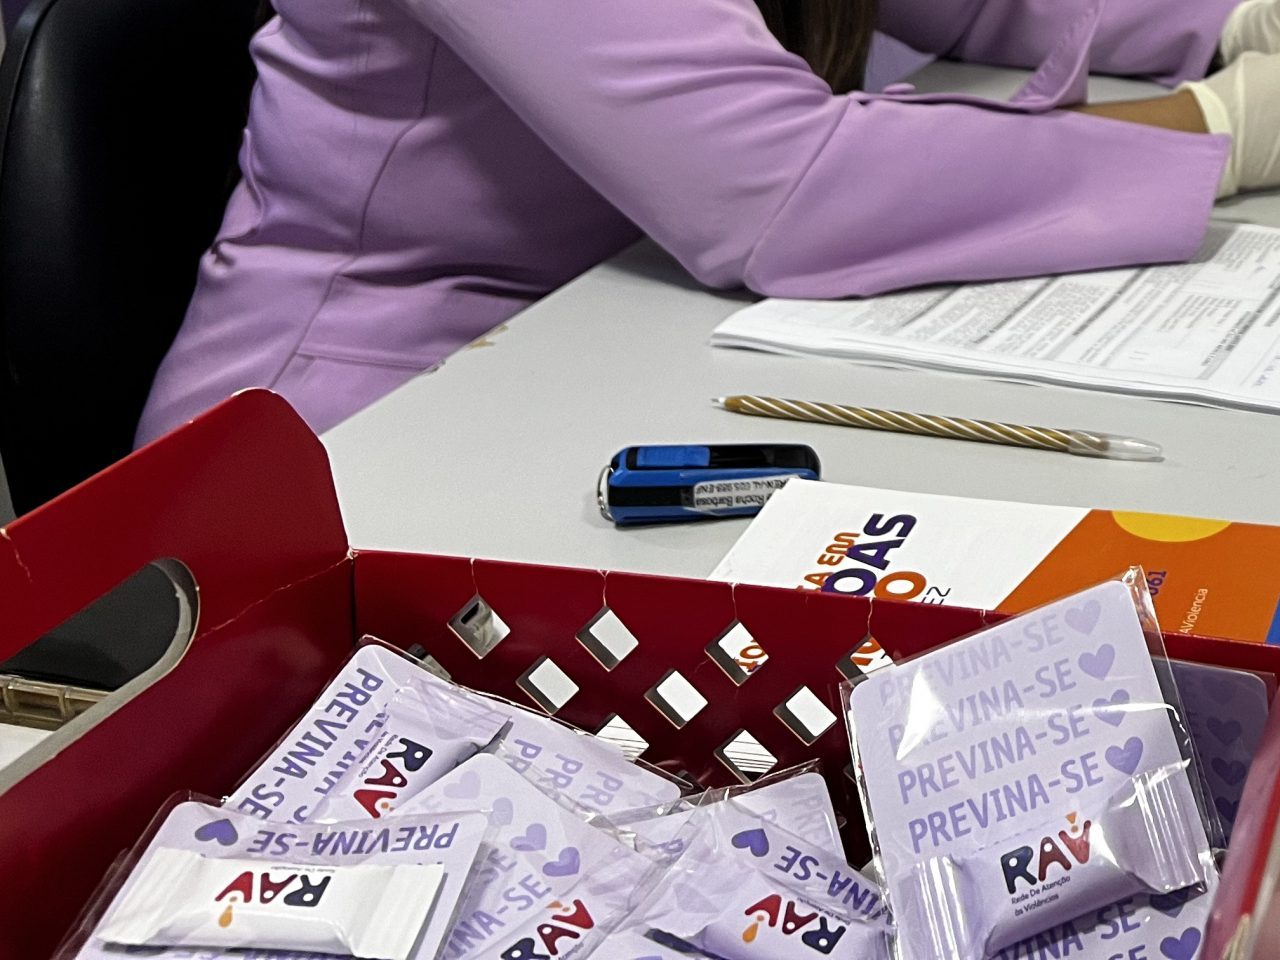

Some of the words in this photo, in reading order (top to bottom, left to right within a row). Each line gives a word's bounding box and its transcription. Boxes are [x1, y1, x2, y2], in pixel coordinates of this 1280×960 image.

[237, 666, 385, 822] PREVINA-SE
[897, 703, 1091, 805] PREVINA-SE
[353, 737, 434, 820] RAV
[908, 750, 1104, 854] PREVINA-SE
[246, 822, 460, 857] PREVINA-SE
[1000, 819, 1092, 895] RAV
[214, 870, 332, 908] RAV
[1011, 893, 1029, 905] Rede
[1030, 888, 1041, 898] De
[1041, 876, 1071, 894] Atenção
[1023, 894, 1060, 913] Violências
[744, 893, 847, 955] RAV
[1002, 898, 1141, 960] VINA-SE
